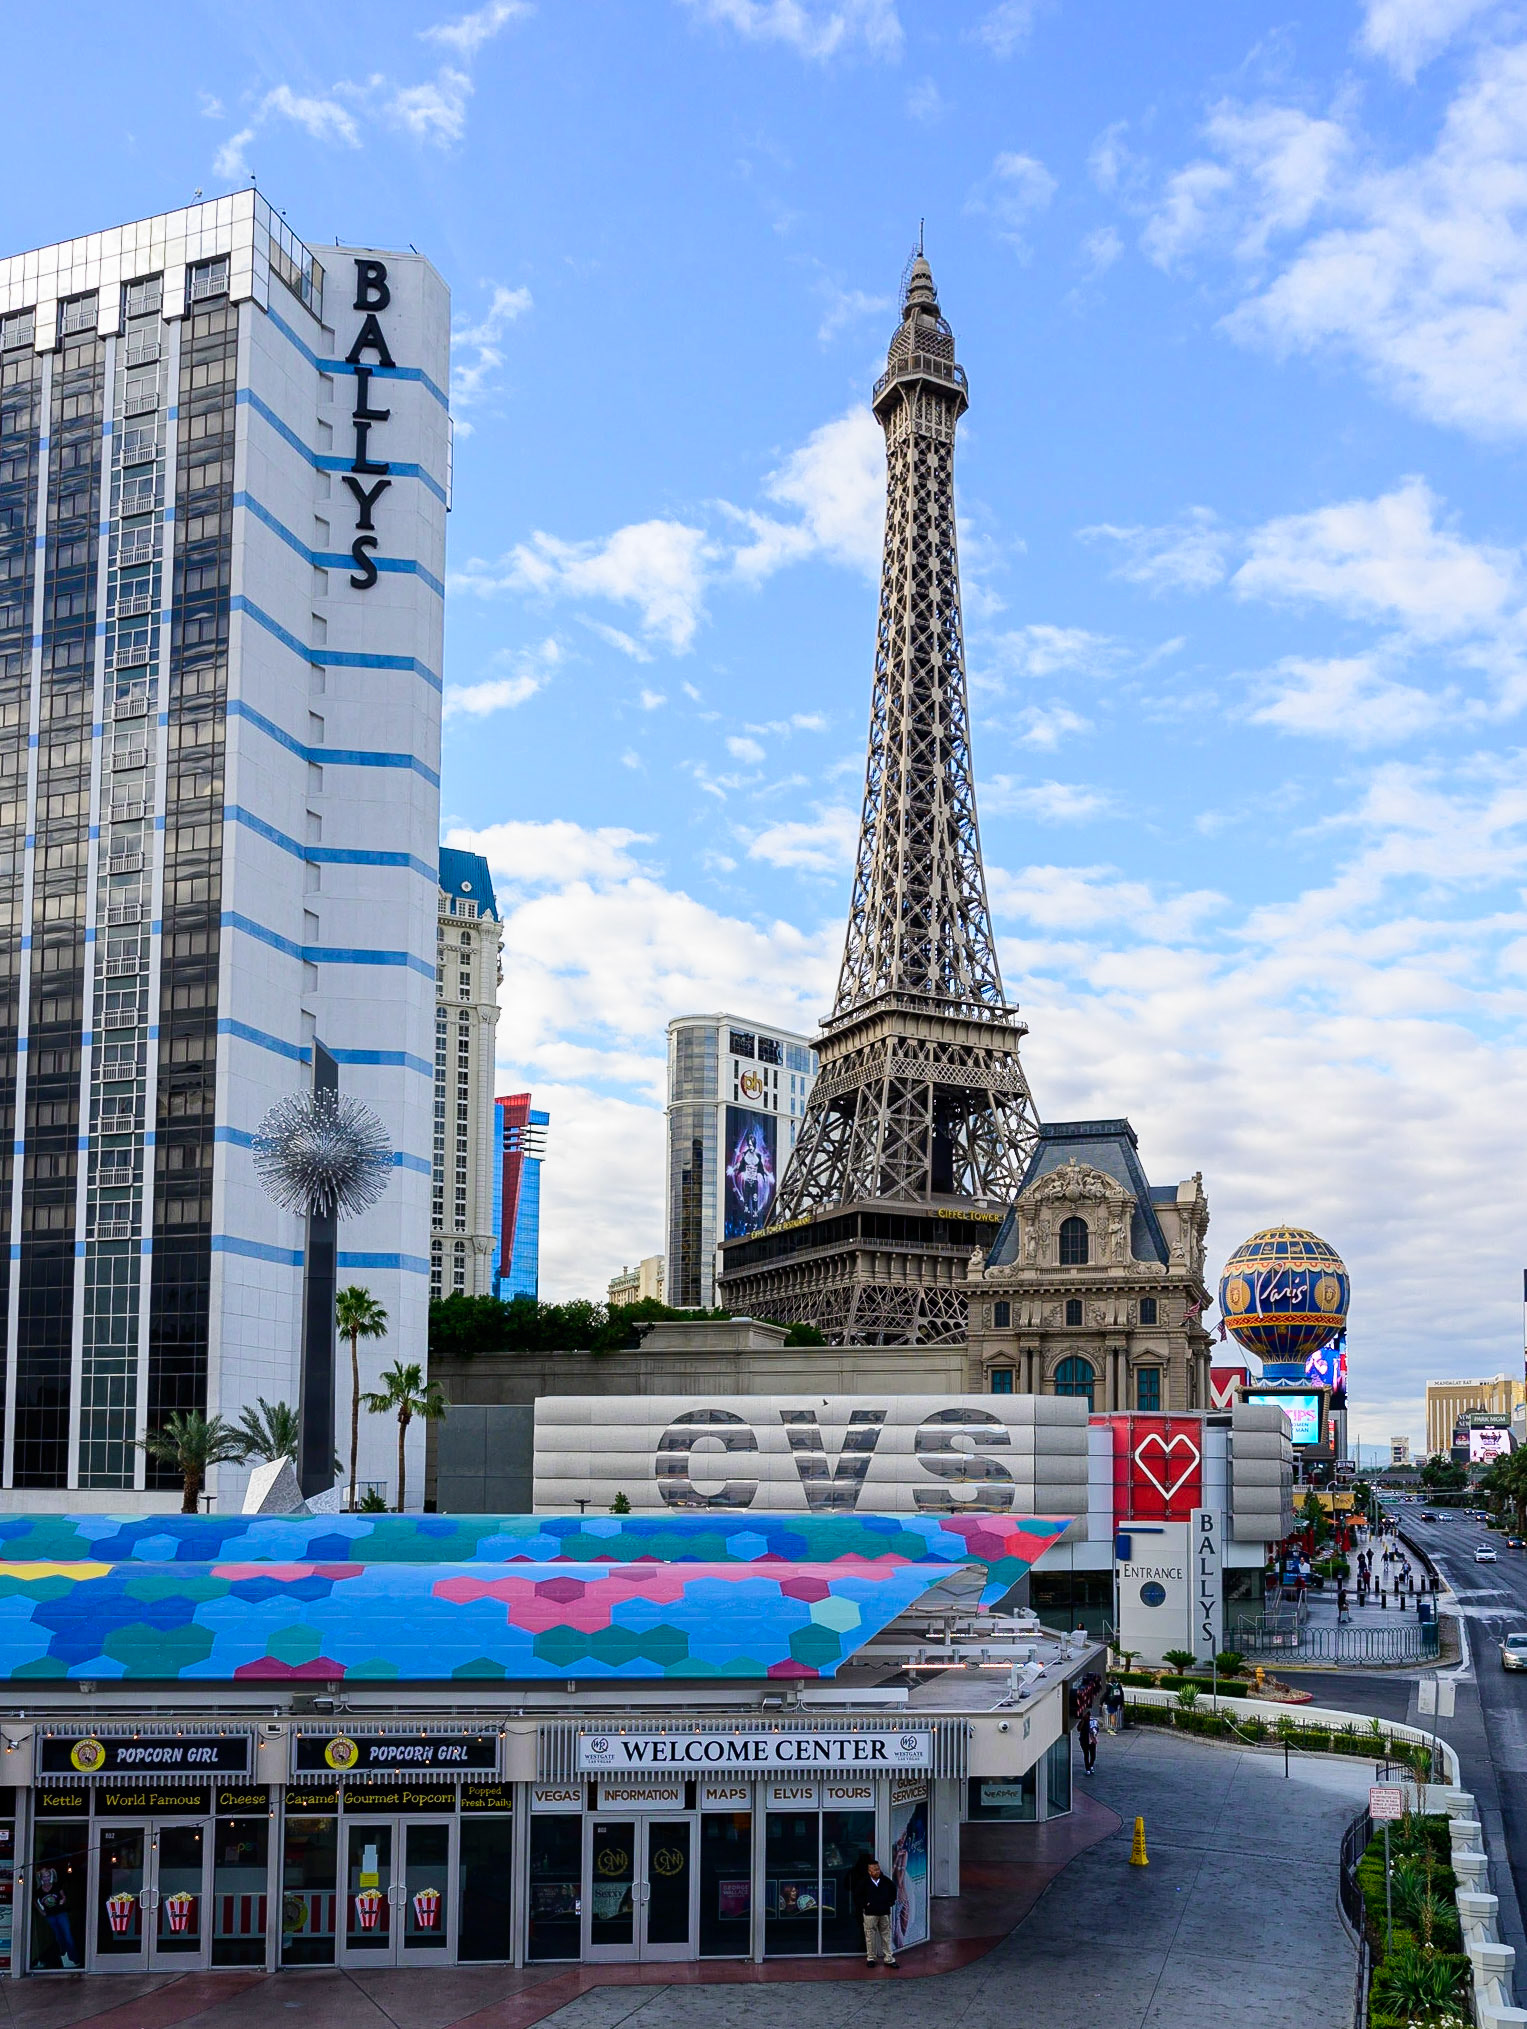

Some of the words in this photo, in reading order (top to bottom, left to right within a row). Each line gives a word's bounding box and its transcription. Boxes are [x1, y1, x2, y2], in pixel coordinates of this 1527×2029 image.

[342, 258, 396, 590] BALLYS
[938, 1208, 967, 1220] EIFFEL
[969, 1210, 999, 1222] TOWER
[1256, 1261, 1308, 1318] Paris
[655, 1409, 1016, 1514] CVS
[1124, 1563, 1183, 1580] ENTRANCE
[1198, 1514, 1216, 1642] BALLYS
[117, 1747, 182, 1763] POPCORN
[187, 1747, 219, 1763] GIRL
[370, 1746, 433, 1761] POPCORN
[437, 1746, 469, 1761] GIRL
[621, 1740, 769, 1762] WELCOME
[775, 1739, 889, 1761] CENTER
[469, 1786, 502, 1795] Popped
[535, 1790, 581, 1801] VEGAS
[604, 1789, 679, 1801] INFORMATION
[706, 1788, 747, 1800] MAPS
[773, 1788, 813, 1800] ELVIS
[827, 1787, 872, 1799] TOURS
[892, 1785, 927, 1803] SERVICES
[43, 1794, 83, 1806] Kettle
[106, 1793, 146, 1806] World
[150, 1793, 201, 1806] Famous
[220, 1792, 266, 1805] Cheese
[285, 1792, 339, 1804] Caramel
[344, 1792, 400, 1805] Gourmet
[403, 1791, 455, 1806] Popcorn
[461, 1798, 486, 1808] Fresh
[488, 1798, 512, 1809] Daily
